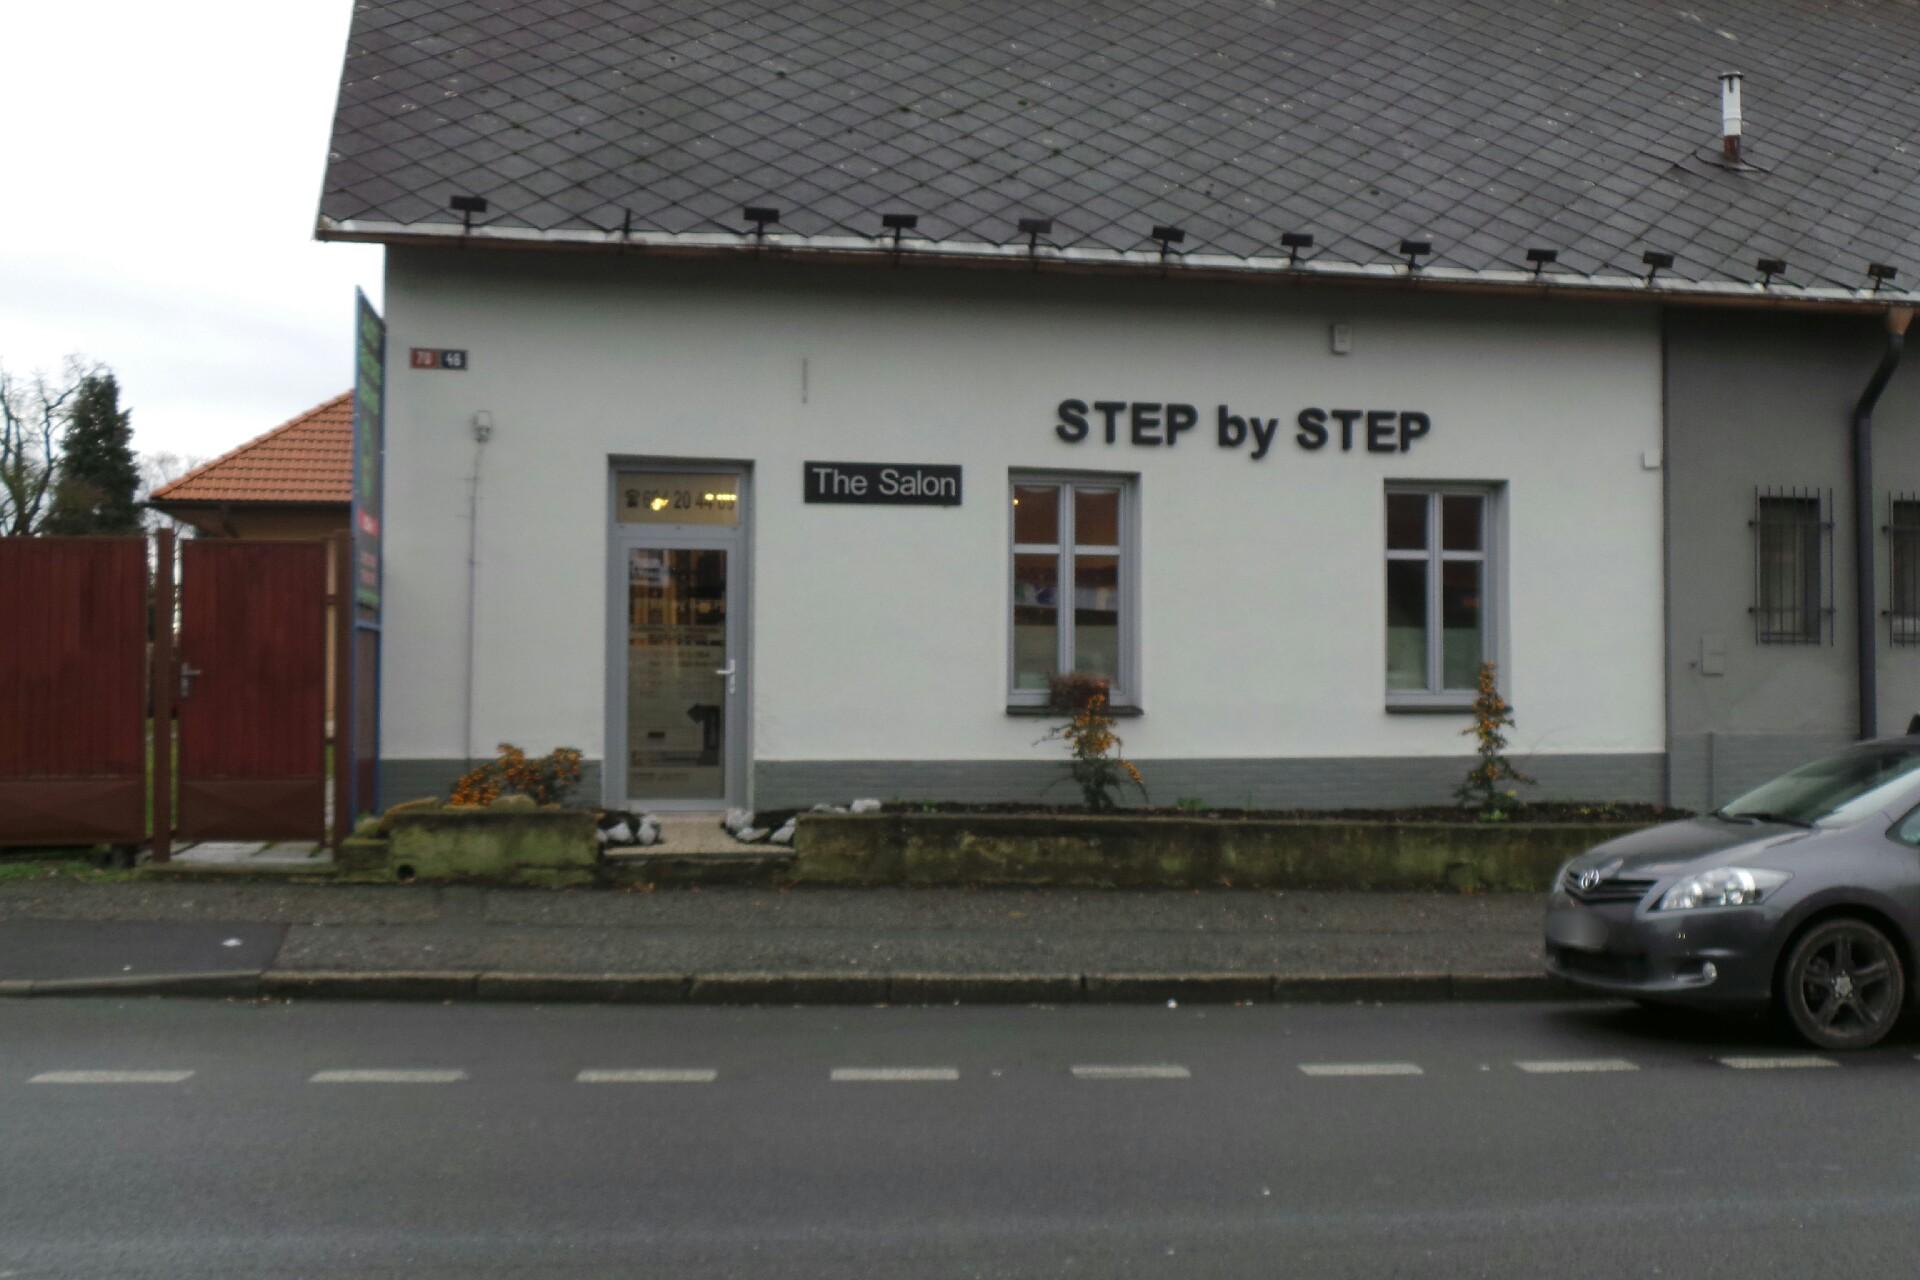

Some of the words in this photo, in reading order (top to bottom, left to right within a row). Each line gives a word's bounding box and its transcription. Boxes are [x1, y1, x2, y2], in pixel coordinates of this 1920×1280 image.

[1056, 398, 1198, 446] STEP
[1217, 404, 1279, 459] by
[1296, 407, 1431, 453] STEP
[812, 467, 868, 495] The
[878, 468, 957, 496] Salon
[673, 489, 691, 509] 20
